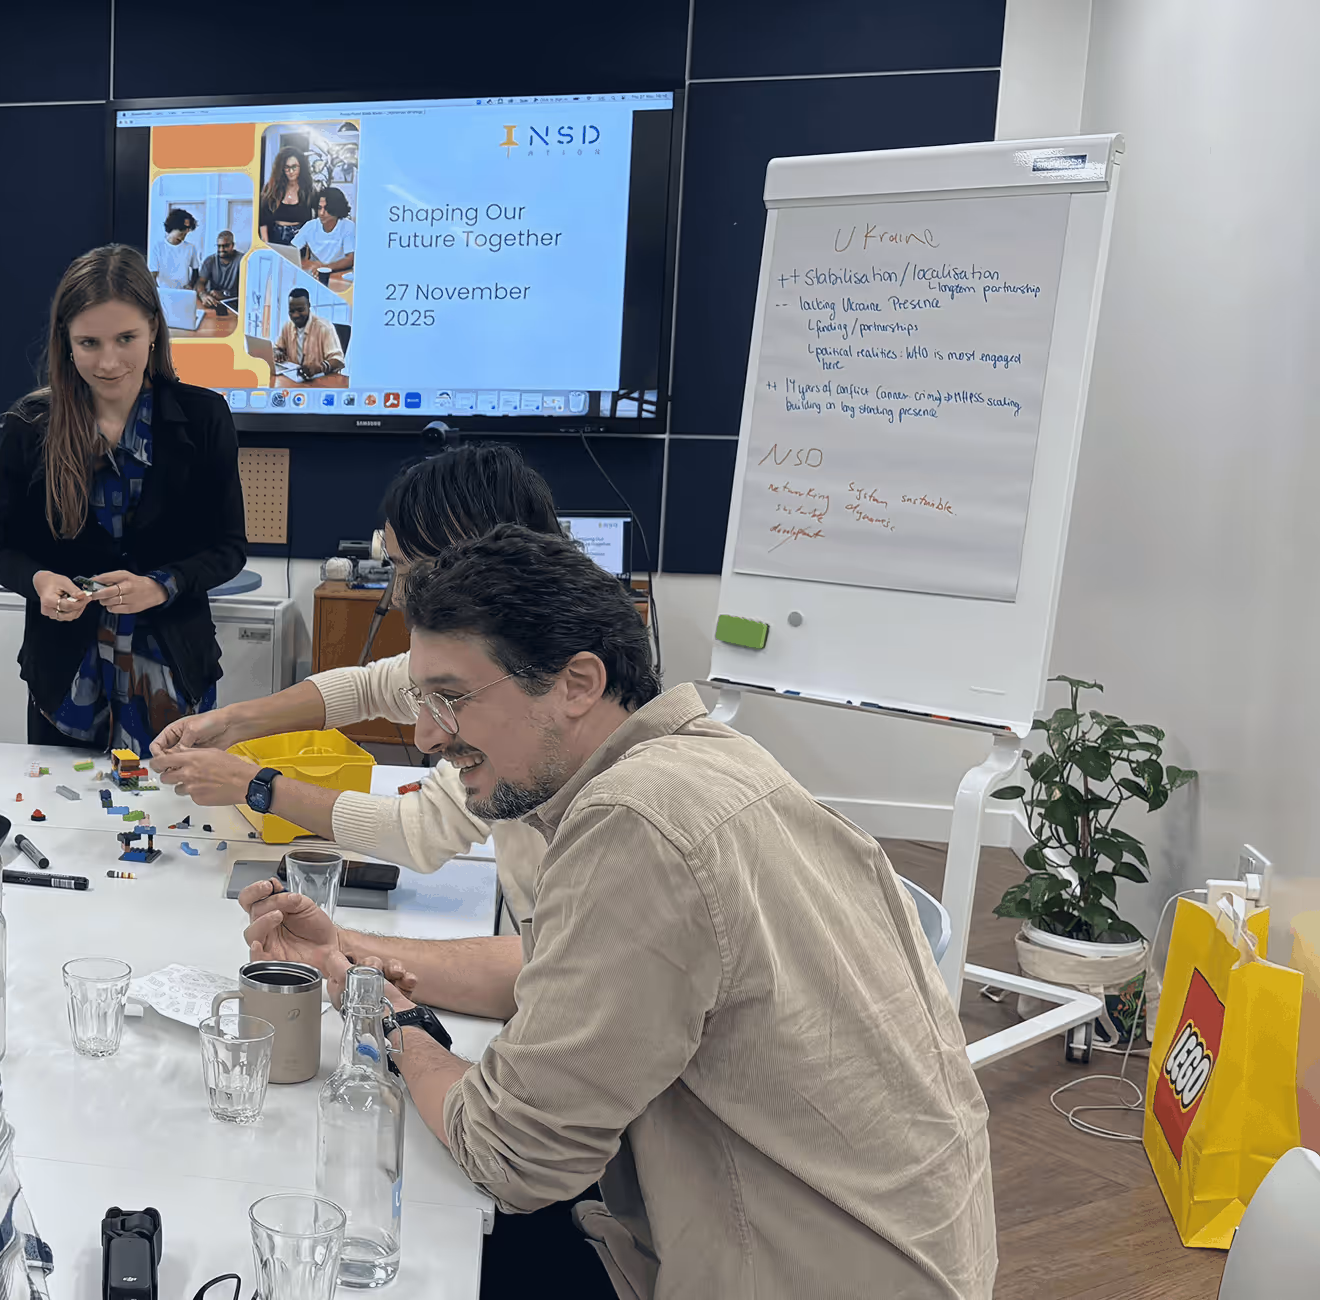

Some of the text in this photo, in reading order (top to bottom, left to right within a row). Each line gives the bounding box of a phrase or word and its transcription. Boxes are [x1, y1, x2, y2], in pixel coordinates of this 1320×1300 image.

[388, 203, 526, 228] Shaping Our
[387, 228, 563, 253] Future Together
[384, 282, 531, 301] 27 November
[982, 281, 1041, 303] partnership
[842, 296, 883, 313] Ukraine
[383, 309, 436, 327] 2025
[815, 344, 853, 363] political
[905, 345, 929, 360] WHO
[933, 348, 944, 361] is
[947, 350, 977, 361] most
[979, 352, 1022, 370] engaged
[822, 357, 846, 371] here
[797, 384, 821, 402] years
[822, 379, 833, 397] of
[785, 395, 822, 415] building
[825, 402, 837, 411] on
[898, 406, 939, 424] presence
[757, 443, 824, 469] NSD
[1164, 1022, 1212, 1110] LEGO
